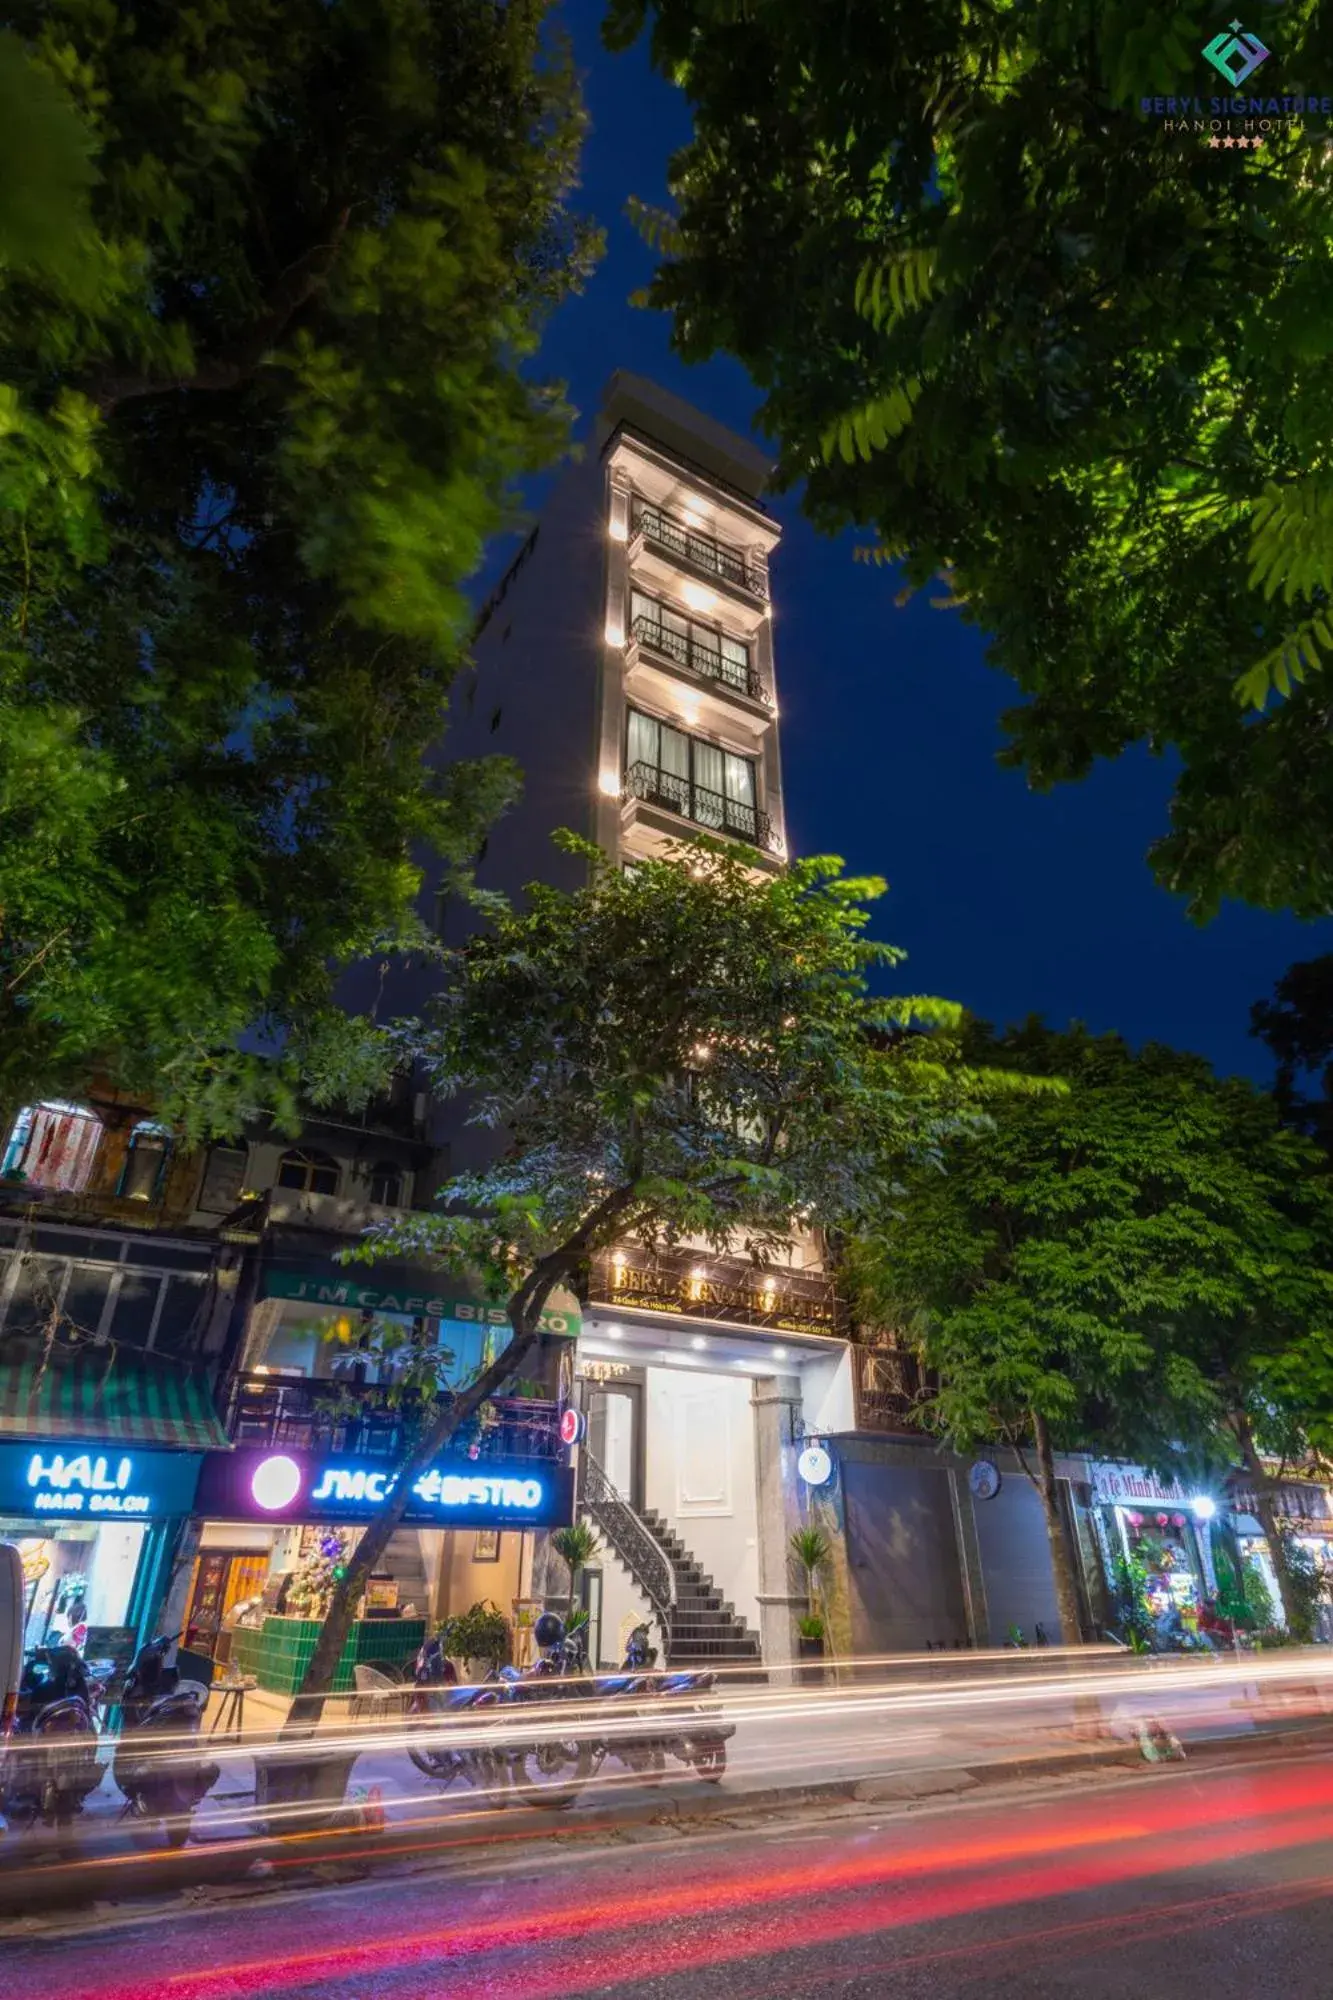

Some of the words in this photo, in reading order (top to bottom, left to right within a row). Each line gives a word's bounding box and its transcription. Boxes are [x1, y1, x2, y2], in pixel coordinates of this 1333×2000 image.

[613, 1264, 677, 1296] BERYL
[357, 1290, 445, 1317] CAFÉ
[455, 1303, 568, 1332] BISRO
[27, 1454, 132, 1490] HALI
[34, 1493, 84, 1510] HAIR
[89, 1495, 150, 1512] SALON
[441, 1475, 542, 1508] BISTRO
